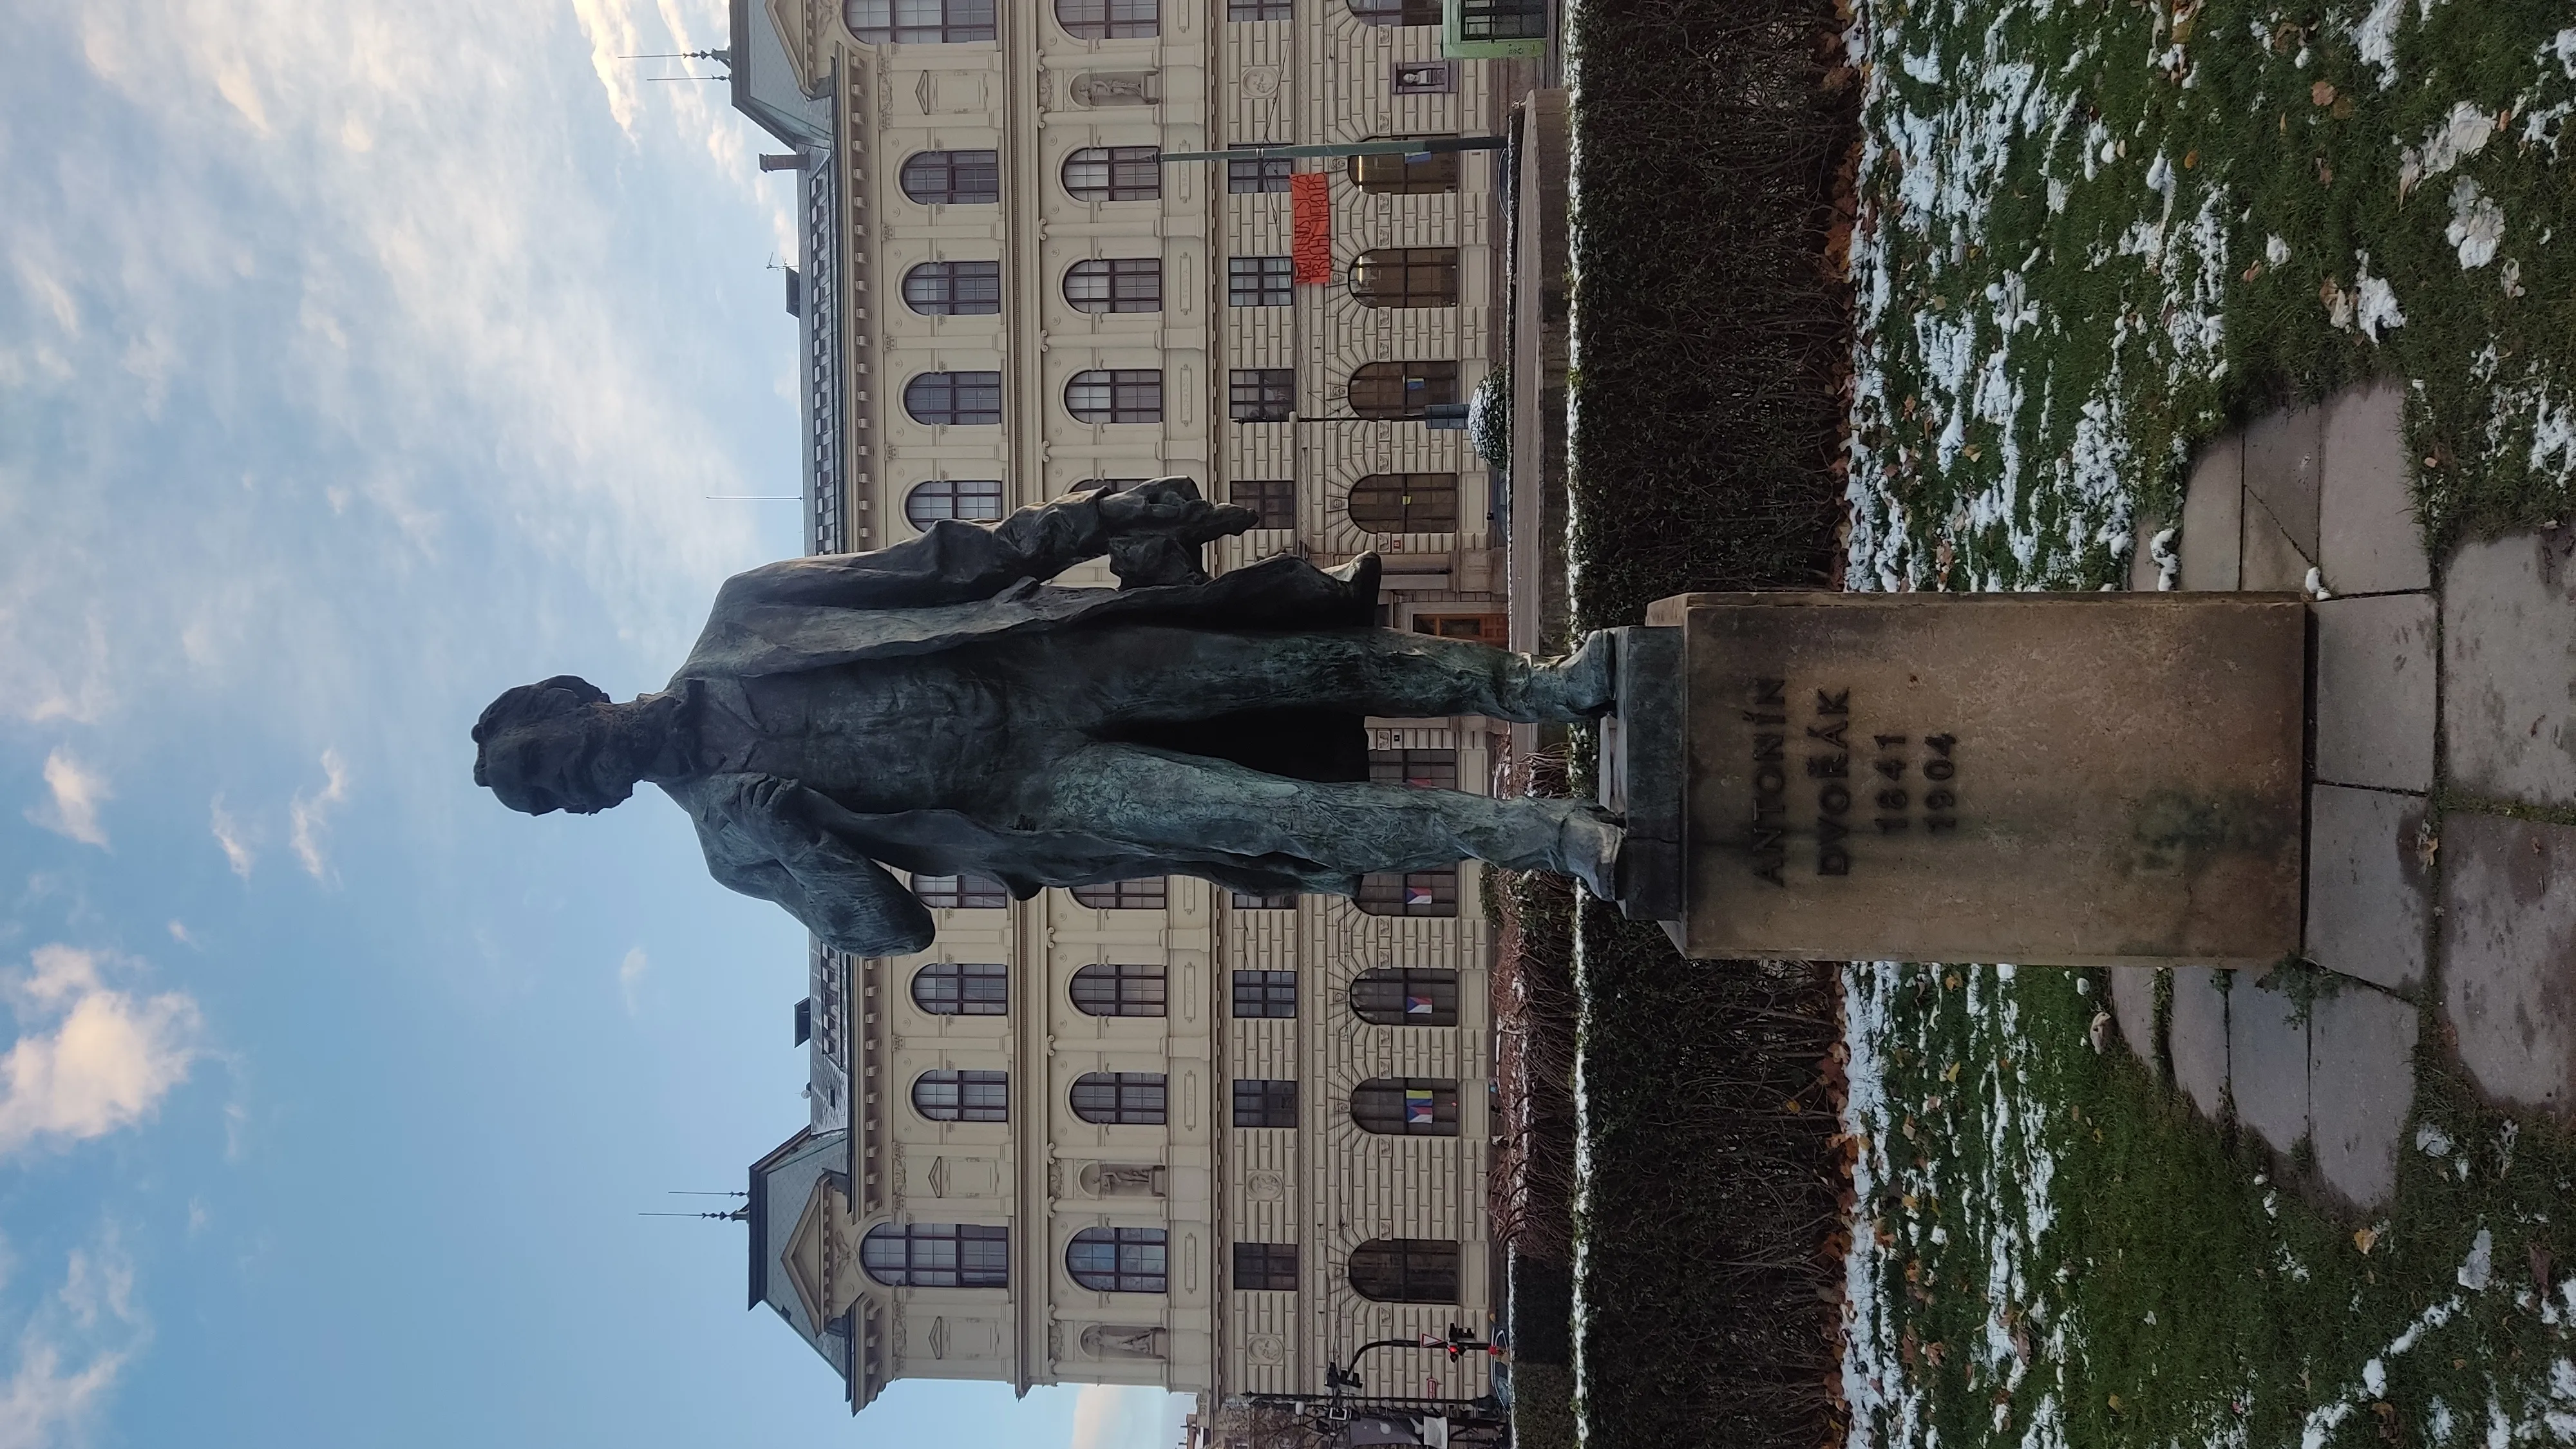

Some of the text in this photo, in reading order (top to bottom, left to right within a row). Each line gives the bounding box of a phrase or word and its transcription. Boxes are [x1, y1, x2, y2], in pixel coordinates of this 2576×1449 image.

[1741, 677, 1785, 887] ANTONÍN
[1806, 687, 1850, 875] DVOŘÁK
[1873, 735, 1908, 833] 1841
[1923, 733, 1956, 831] 1904
